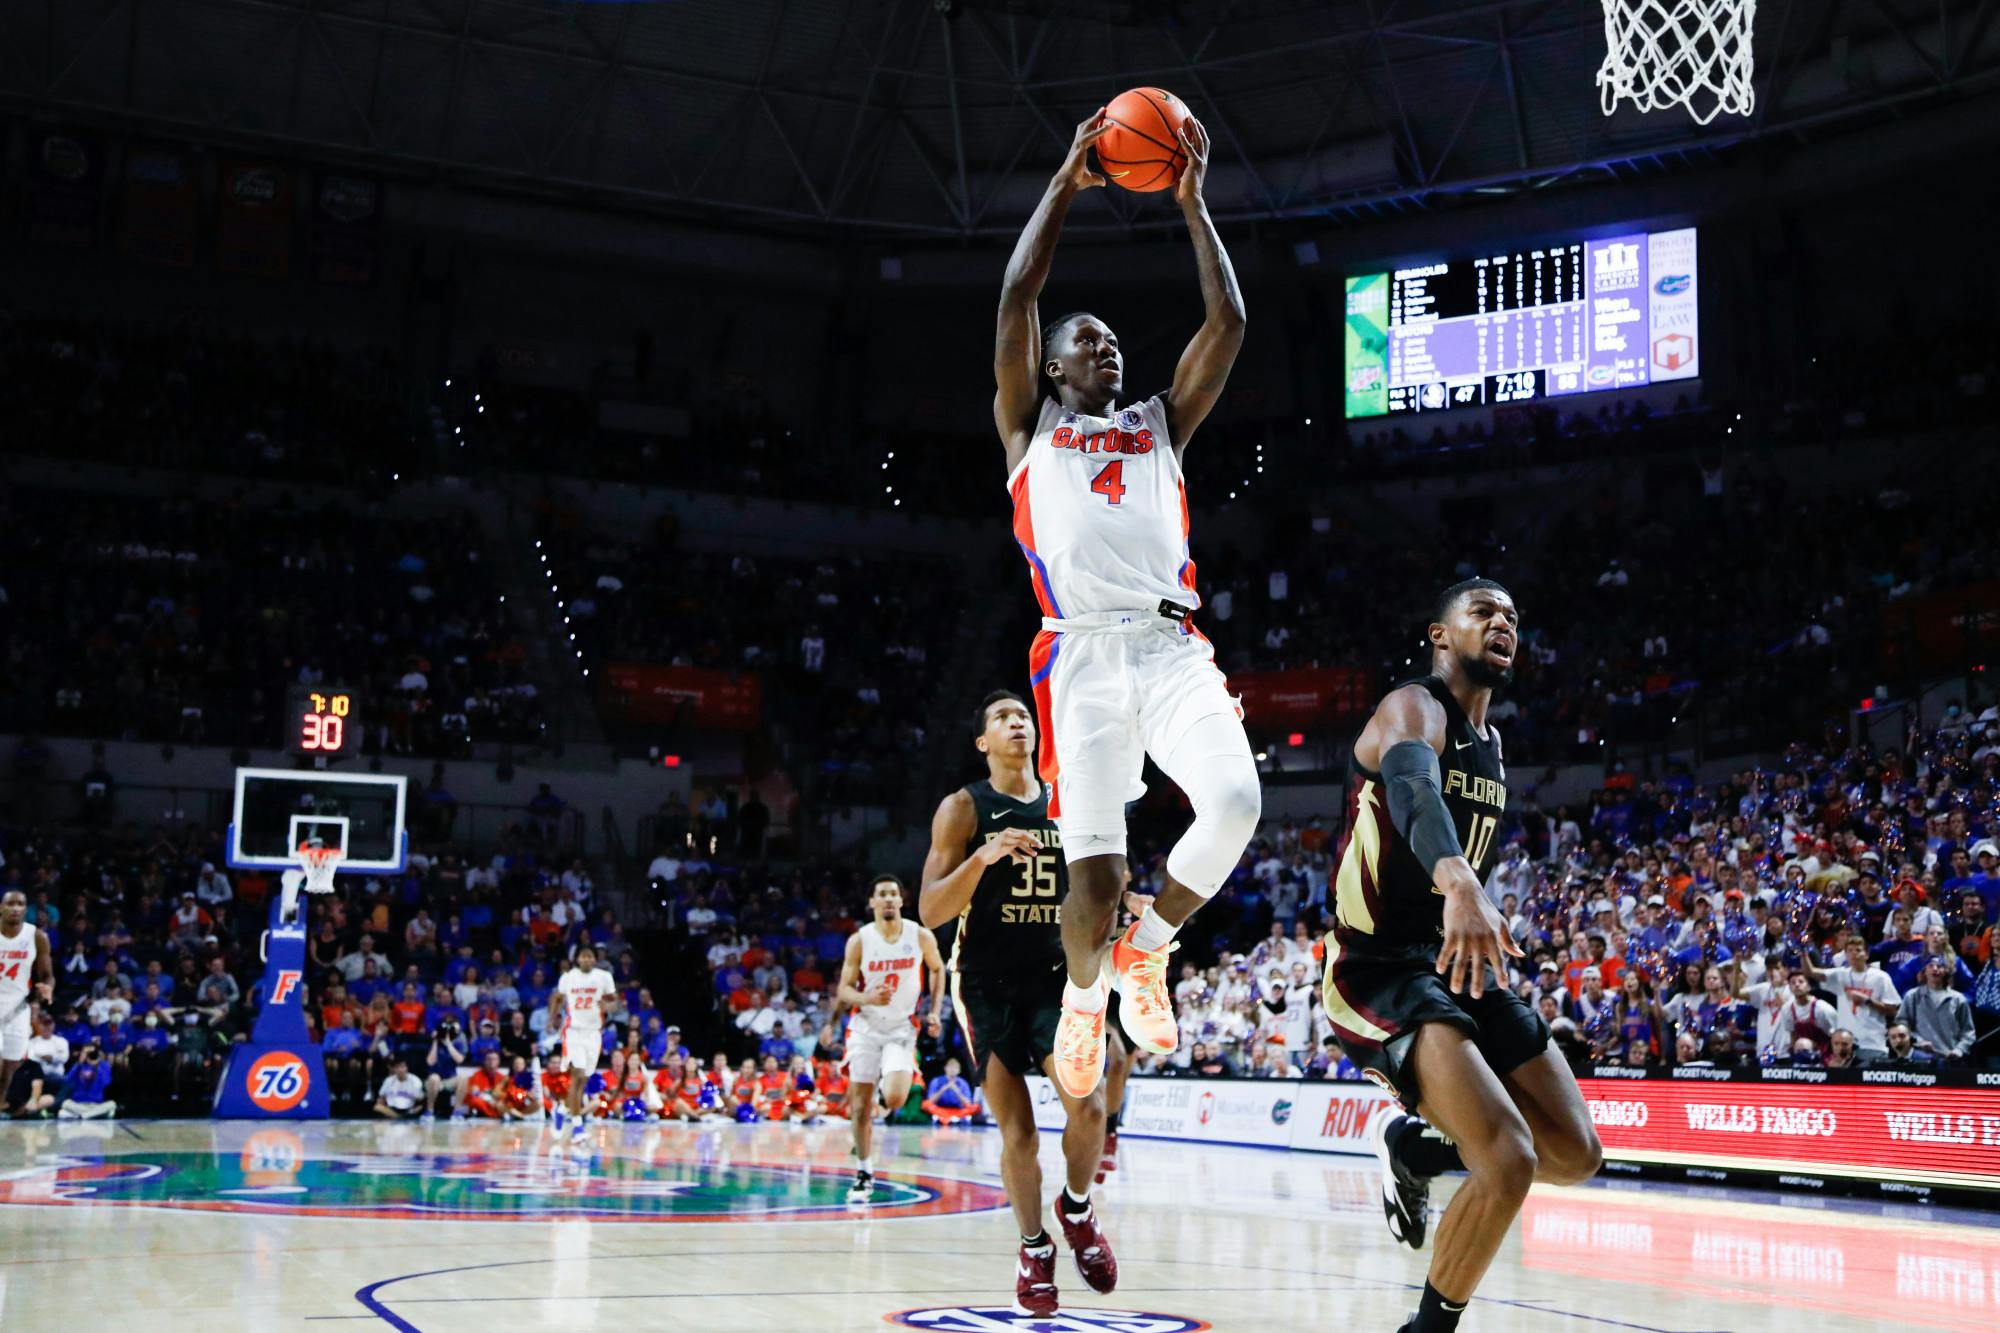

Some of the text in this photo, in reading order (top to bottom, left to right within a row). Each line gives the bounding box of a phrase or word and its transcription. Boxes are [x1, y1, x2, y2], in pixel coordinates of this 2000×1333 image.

[1455, 385, 1475, 402] 47
[1495, 371, 1535, 393] 7:10
[1051, 427, 1153, 455] GATORS
[1091, 459, 1126, 505] 4
[310, 693, 350, 717] 7:10
[302, 714, 343, 751] 30
[1464, 812, 1496, 870] 10
[1011, 855, 1056, 897] 35
[269, 969, 303, 1005] F
[574, 996, 593, 1009] 22
[253, 1062, 302, 1099] 76
[1672, 1067, 1731, 1080] ROCKET Mortgage
[1762, 1068, 1827, 1083] ROCKET Mortgage
[1862, 1071, 1936, 1086] ROCKET Mortgage
[1133, 1085, 1191, 1108] Tower Hill
[1131, 1113, 1184, 1132] Insurance
[1586, 1100, 1648, 1127] FARGO
[1685, 1103, 1836, 1136] WELLS FARGO
[1884, 1112, 1975, 1144] WELLS
